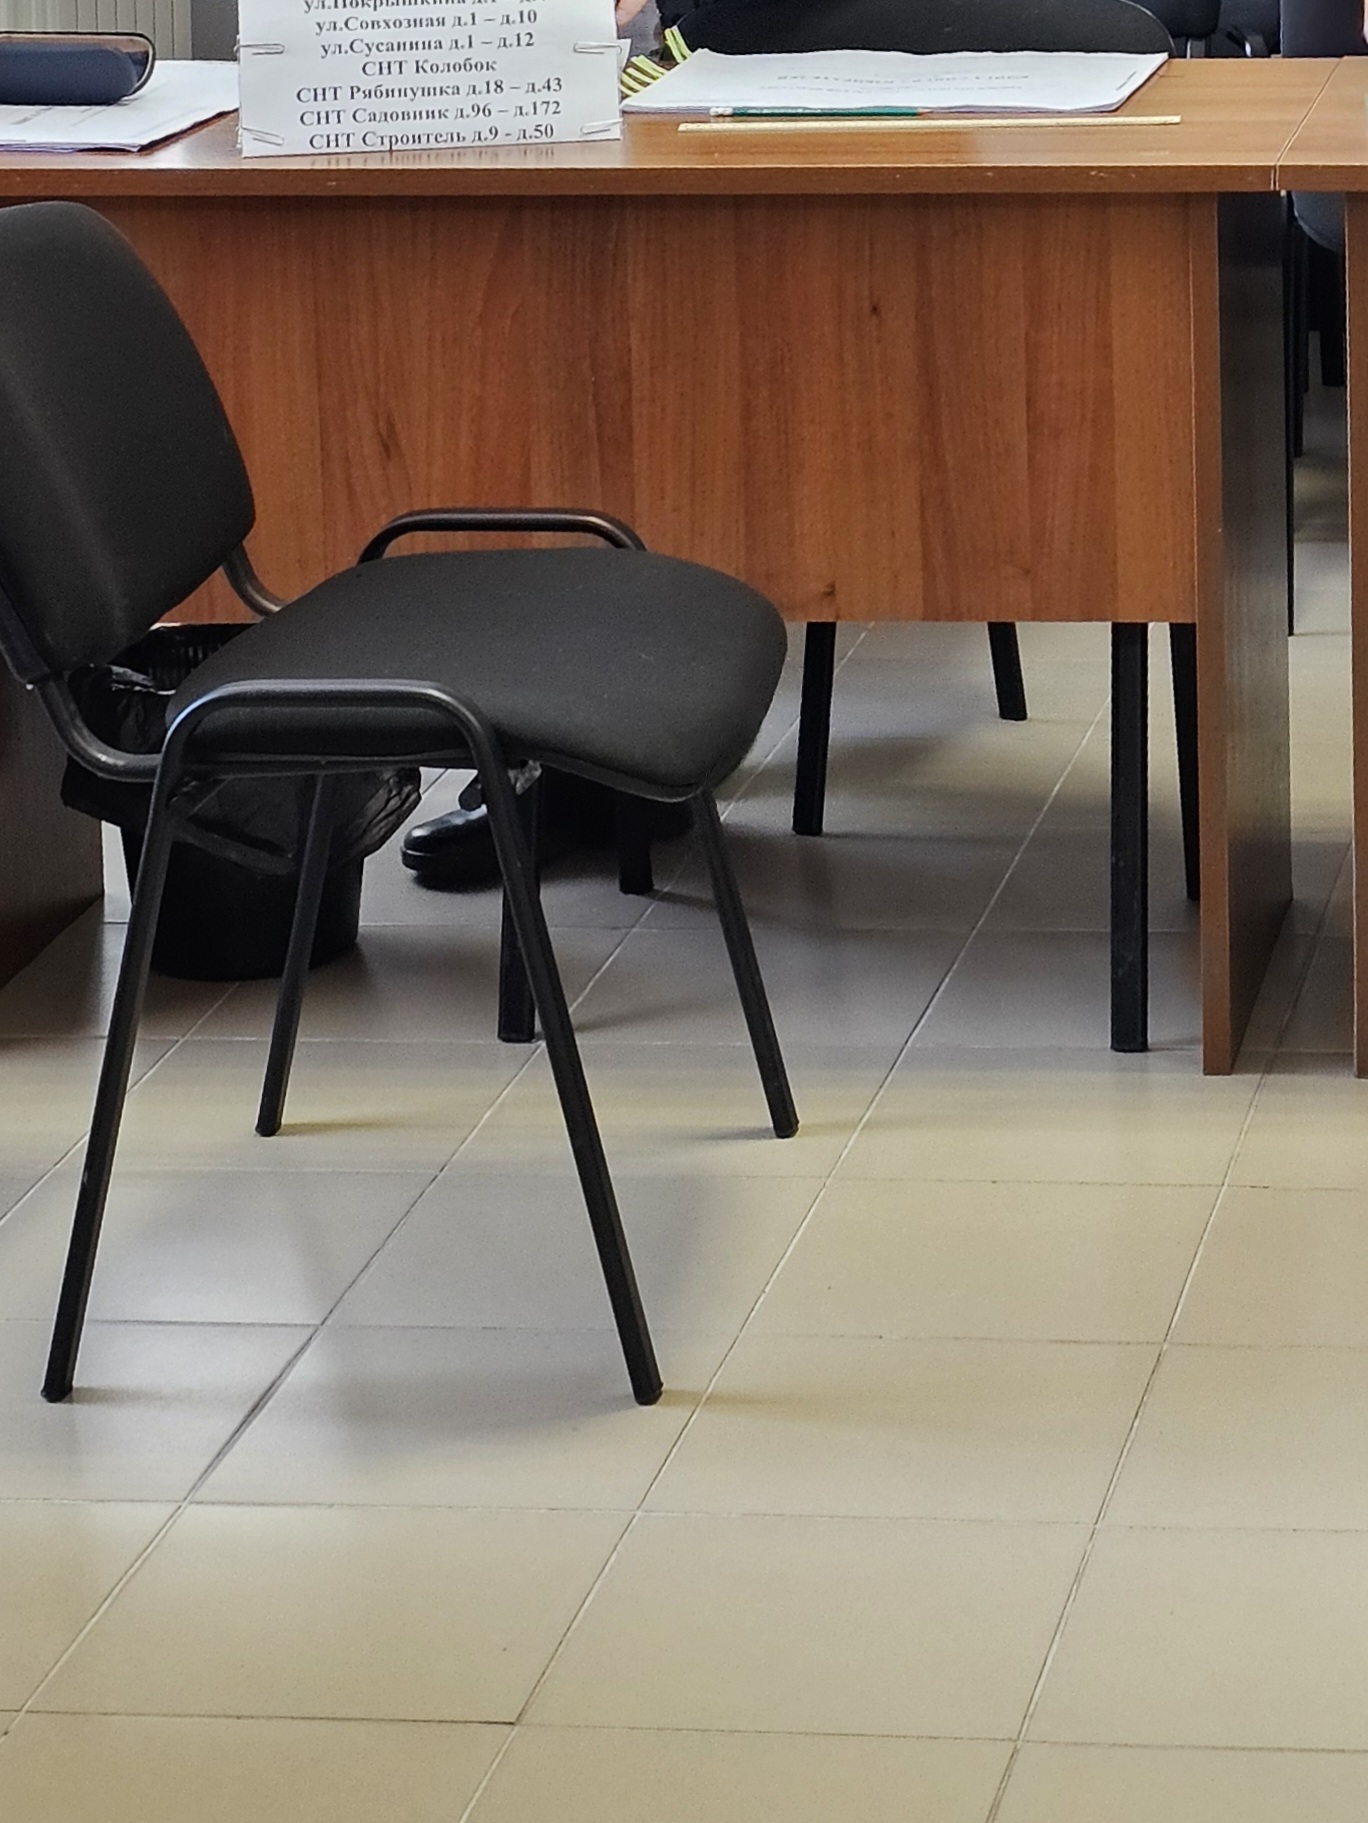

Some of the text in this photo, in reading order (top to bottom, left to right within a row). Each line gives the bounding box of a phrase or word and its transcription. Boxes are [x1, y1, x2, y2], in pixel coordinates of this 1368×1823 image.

[315, 16, 446, 35] ул.Совхозная
[452, 12, 477, 28] д.1
[500, 9, 537, 26] д.10
[321, 38, 443, 59] ул.Сусанина
[449, 35, 473, 51] д.1
[497, 32, 535, 49] д.12
[362, 58, 498, 76] СНТ Колобок
[296, 87, 342, 103] СНТ
[350, 84, 460, 102] Рябинушка
[466, 79, 504, 97] д.18
[525, 77, 562, 94] д.43
[299, 109, 346, 127] СНТ
[352, 107, 449, 124] Садовник
[454, 103, 492, 120] д.96
[513, 100, 561, 118] д.172
[309, 132, 355, 150] СНТ
[362, 130, 466, 150] Строитель
[471, 126, 498, 143] д.9
[516, 124, 554, 141] д.50
